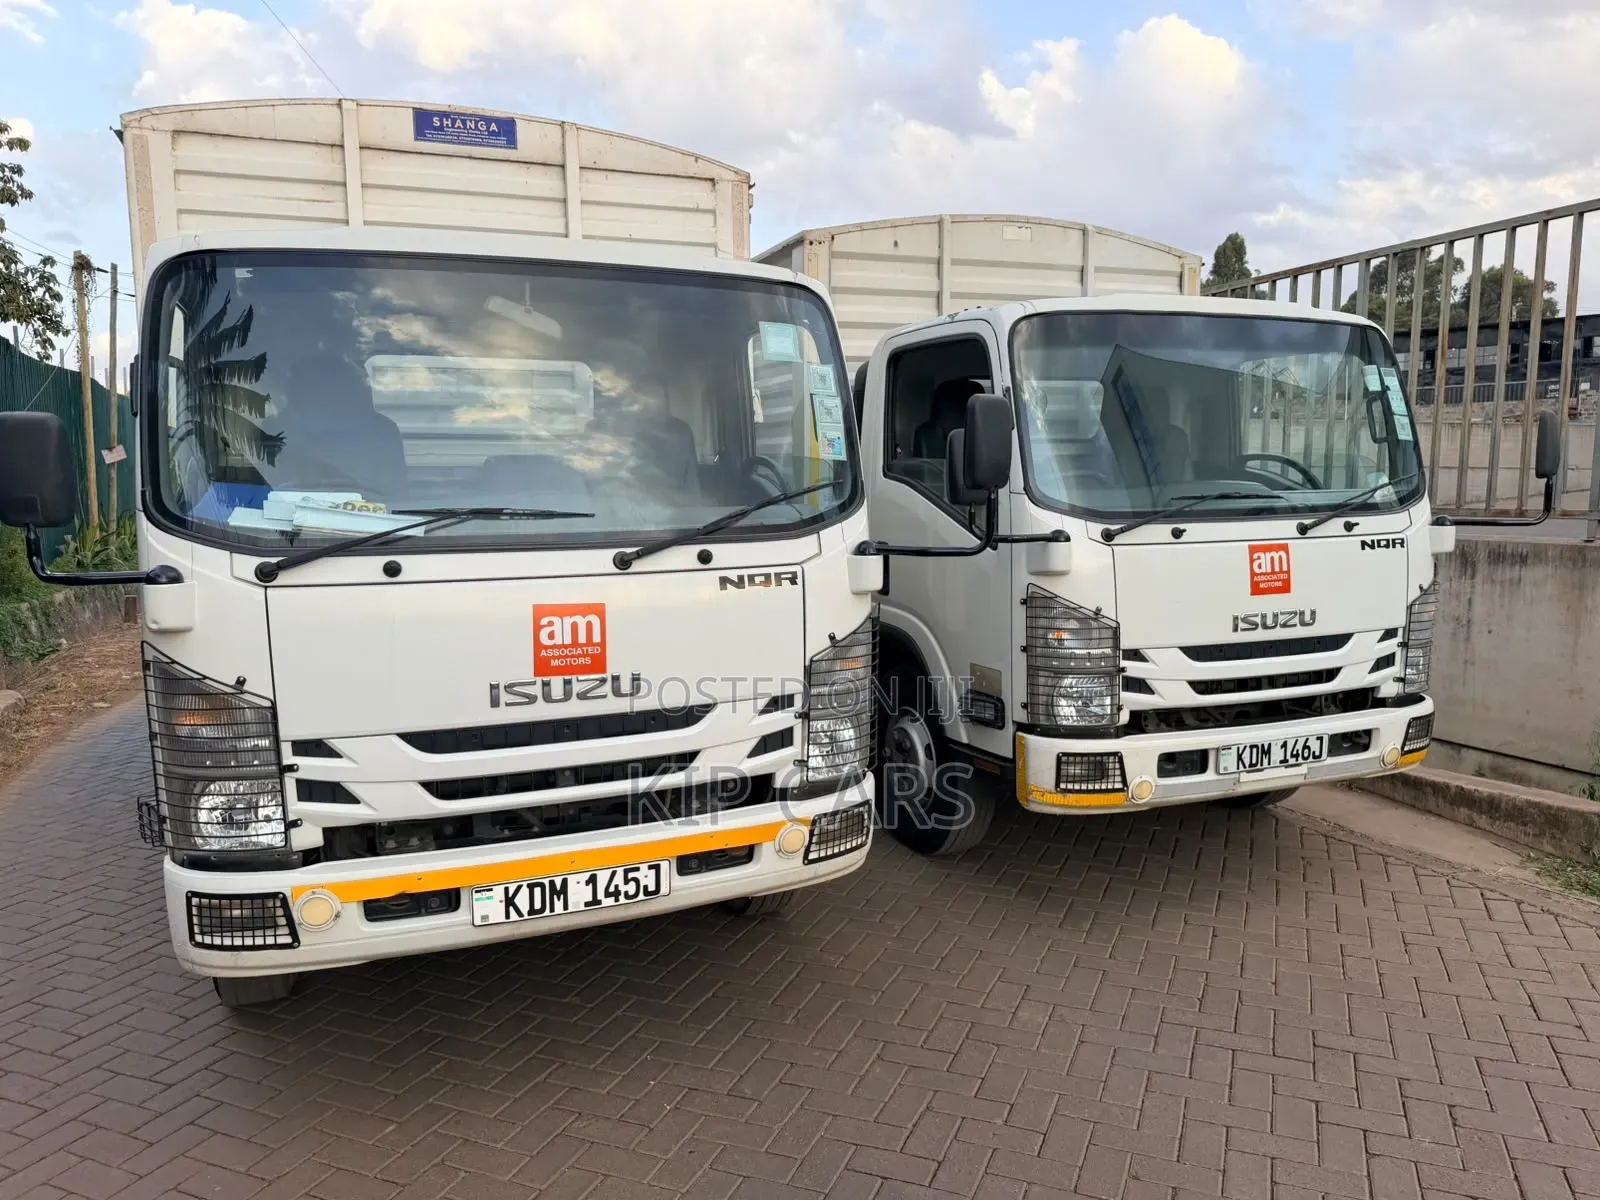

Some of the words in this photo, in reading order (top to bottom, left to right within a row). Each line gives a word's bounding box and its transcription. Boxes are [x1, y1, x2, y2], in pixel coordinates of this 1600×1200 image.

[433, 117, 499, 132] SHANGA
[1361, 538, 1405, 550] NQR
[1253, 551, 1288, 573] am
[718, 571, 798, 591] NQR
[1254, 574, 1288, 582] ASSOCIATED
[539, 613, 601, 646] am
[1232, 608, 1316, 633] ISUZU
[540, 647, 601, 657] ASSOCIATED
[550, 657, 592, 667] MOTORS
[490, 671, 641, 708] ISUZU
[1236, 742, 1272, 770] KDM
[1279, 736, 1324, 765] 146J
[504, 877, 569, 920] KDM
[584, 863, 661, 908] 145J
